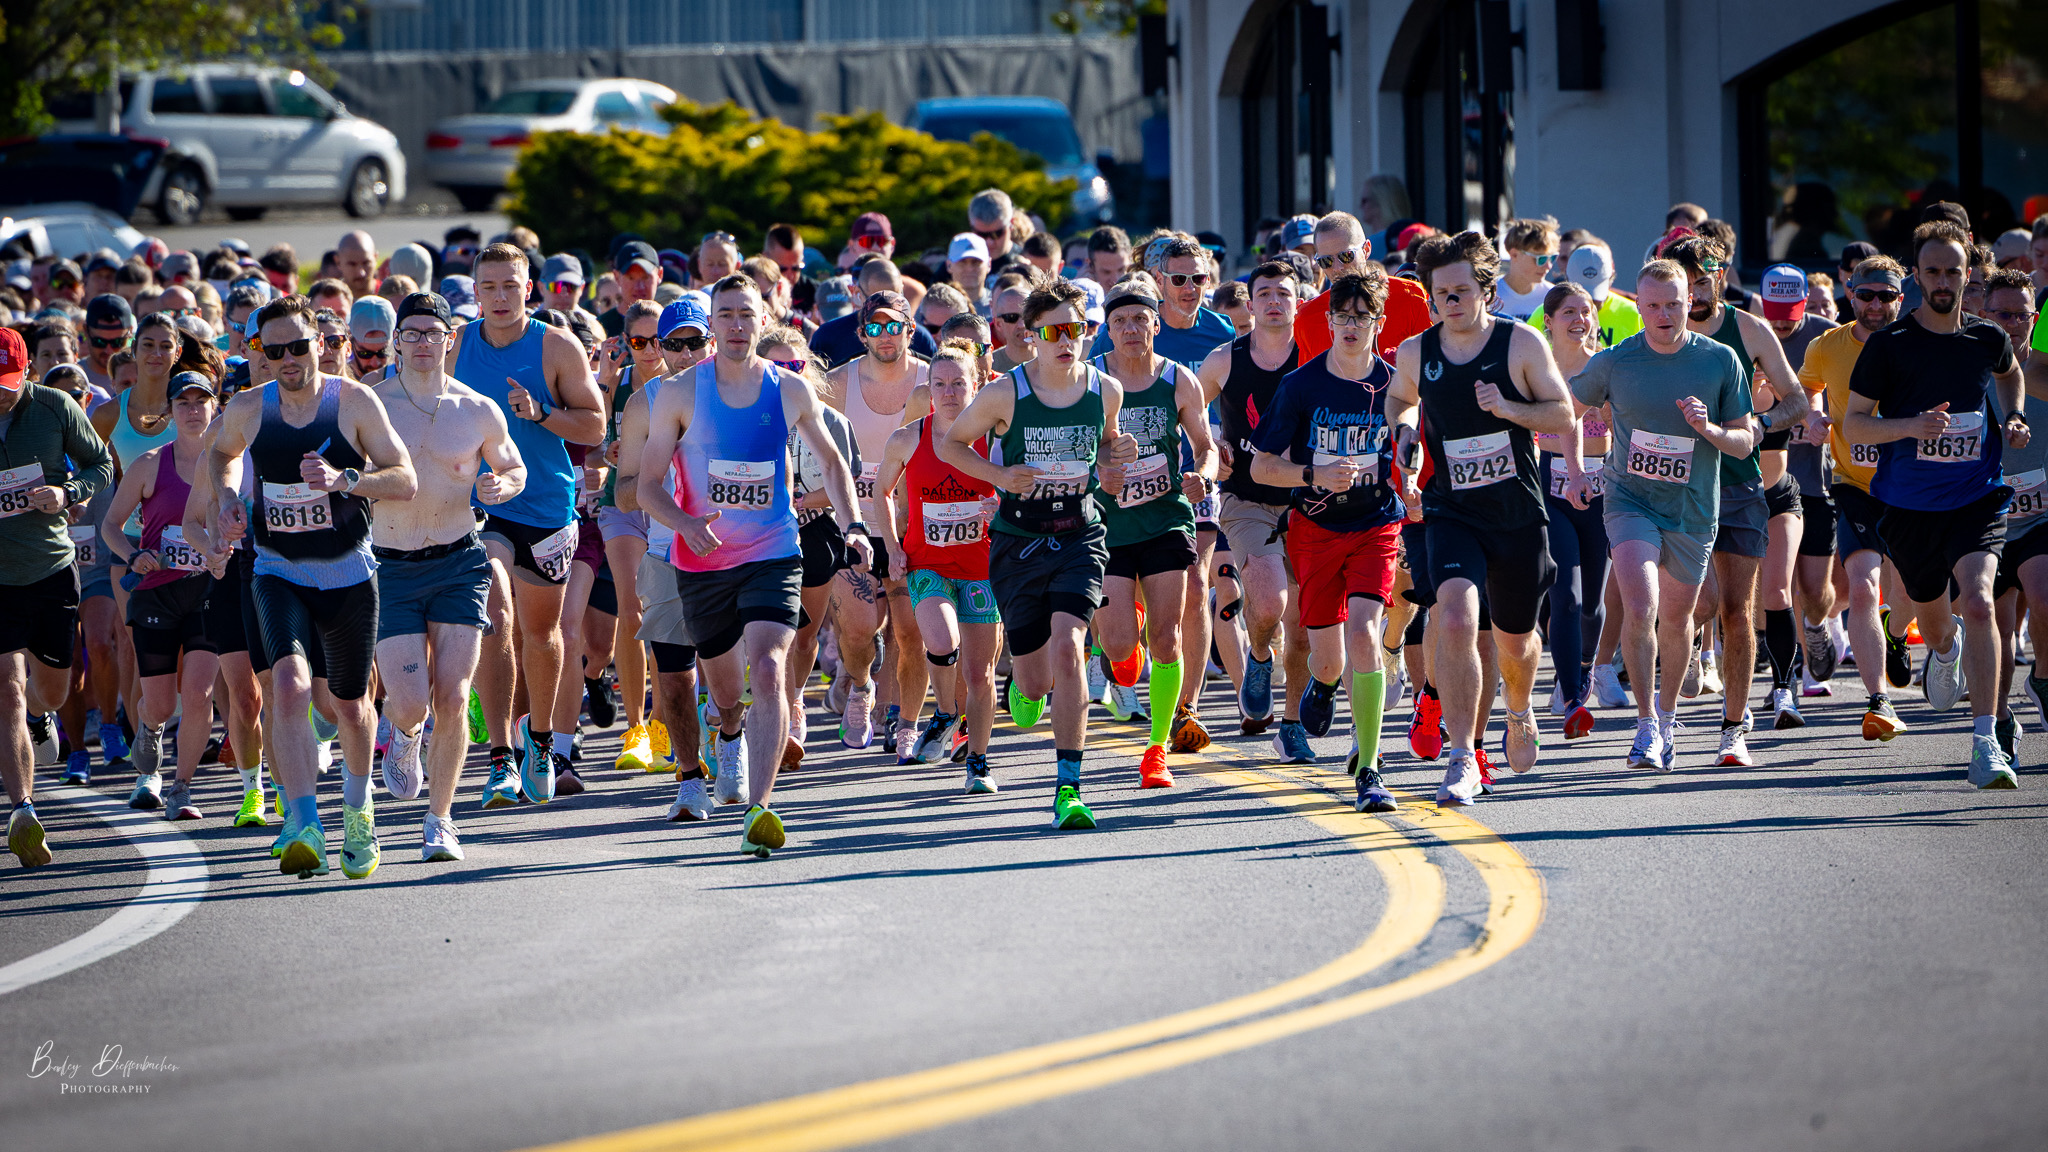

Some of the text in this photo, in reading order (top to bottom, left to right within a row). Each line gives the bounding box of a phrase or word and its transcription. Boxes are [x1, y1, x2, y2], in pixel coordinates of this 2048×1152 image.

[1312, 407, 1387, 430] Wyoming
[1024, 427, 1065, 441] WYOMING
[1310, 423, 1388, 454] SEMINARY
[1025, 440, 1055, 453] VALLEY
[1138, 445, 1157, 456] EAM
[1922, 435, 1978, 457] 8637
[1453, 455, 1511, 485] 8242
[1631, 452, 1687, 479] 8856
[711, 483, 769, 506] 8845
[922, 487, 973, 497] DALTON
[1555, 476, 1601, 495] 73
[269, 504, 327, 528] 8618
[928, 521, 979, 543] 8703
